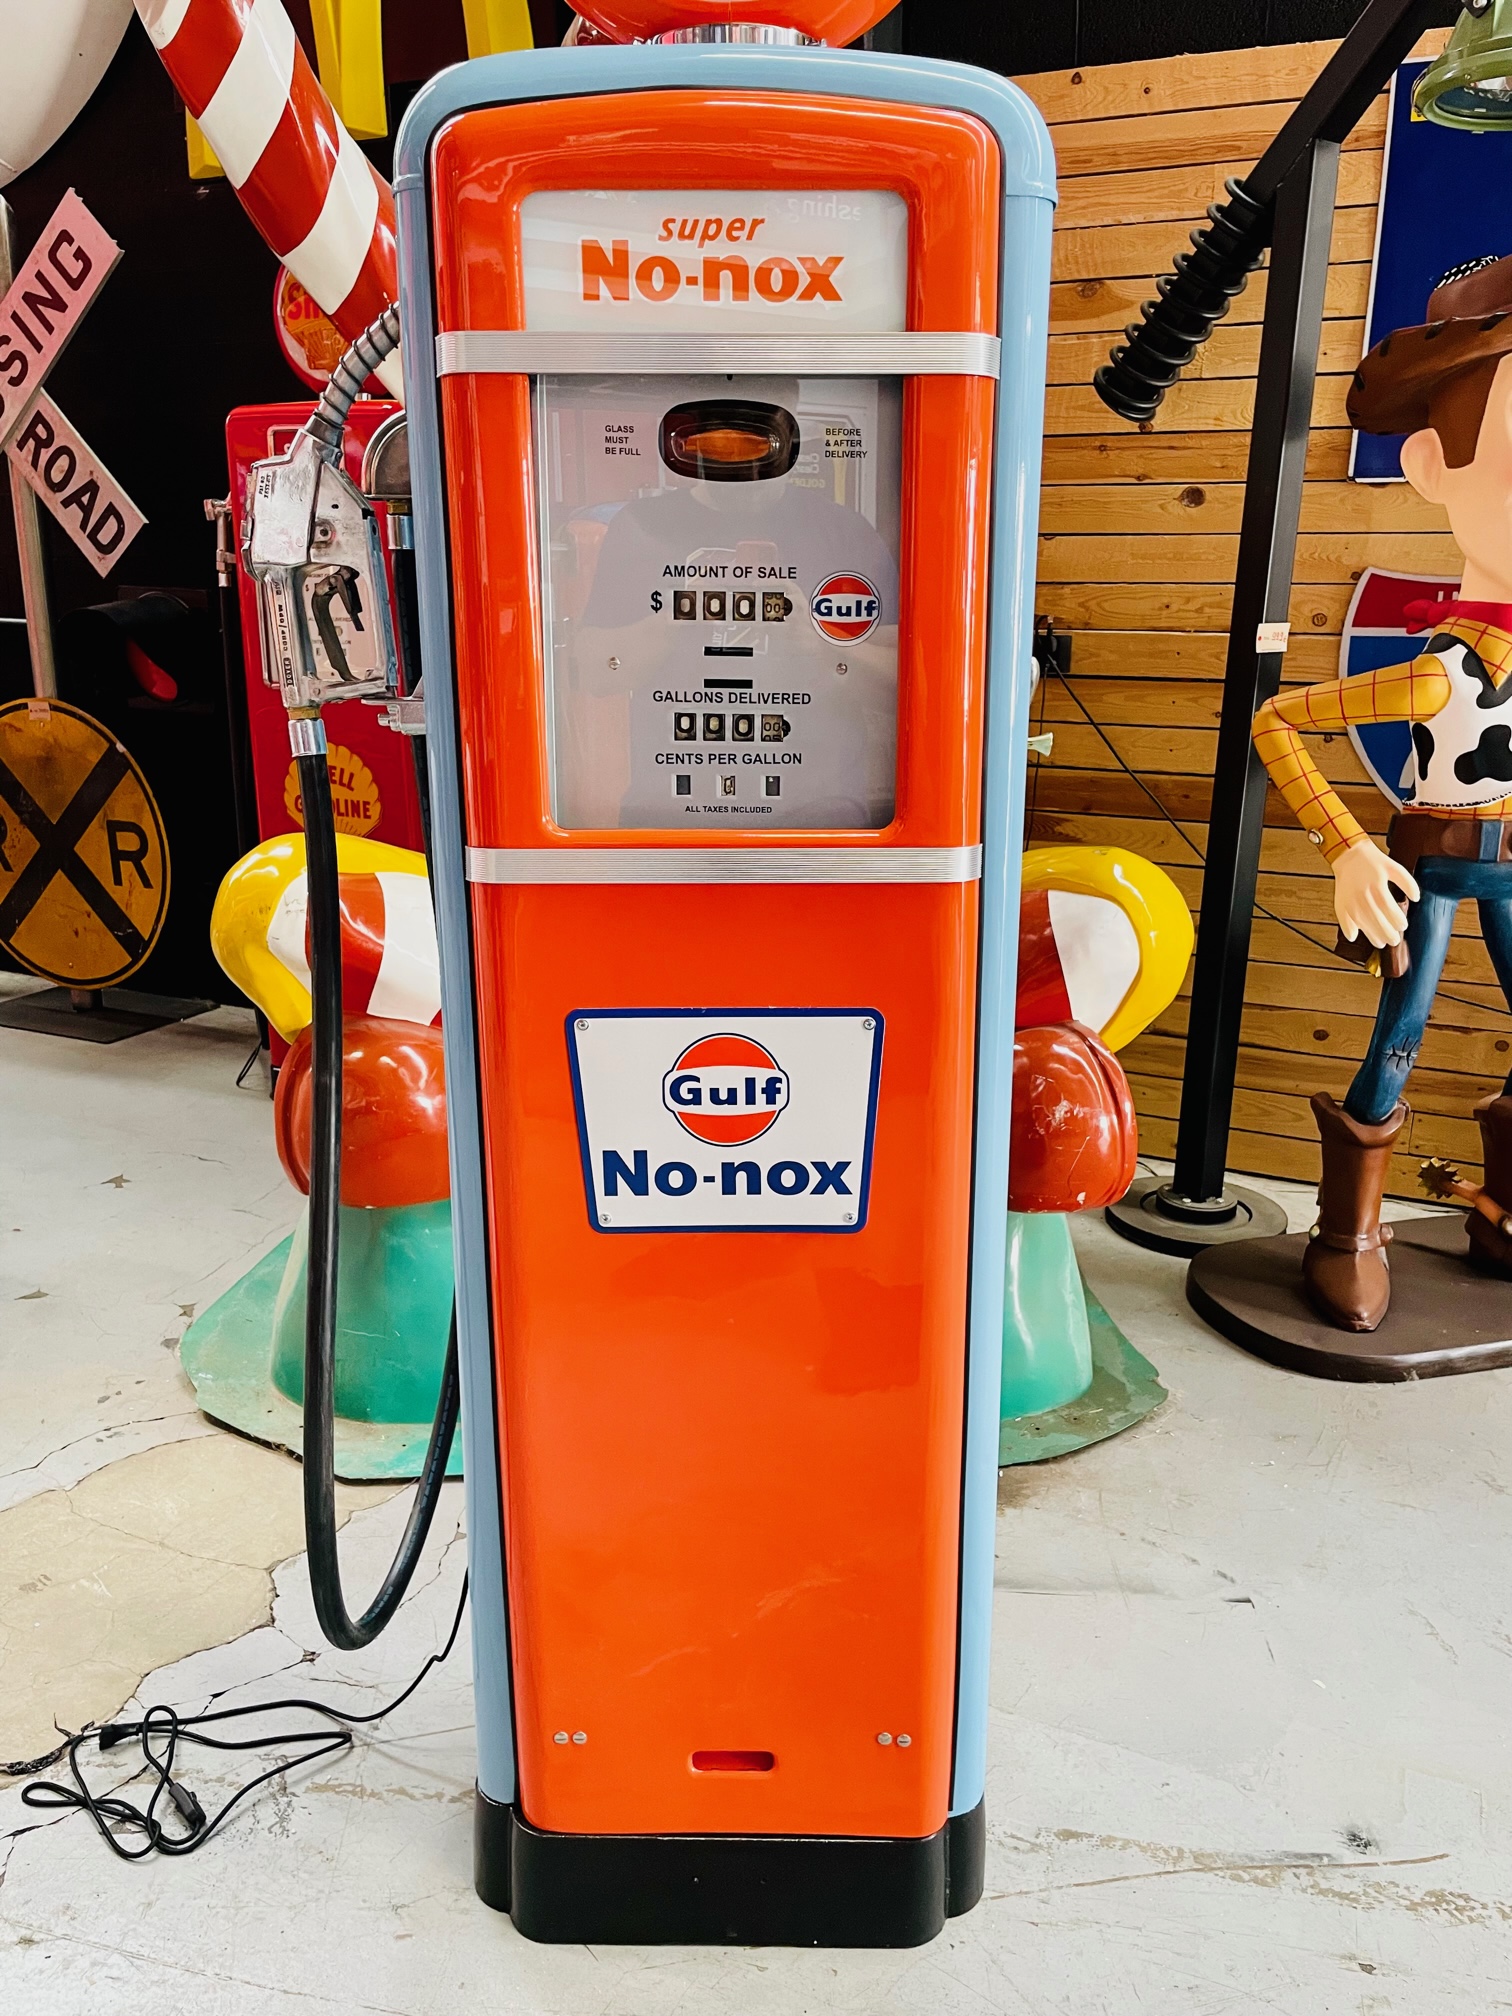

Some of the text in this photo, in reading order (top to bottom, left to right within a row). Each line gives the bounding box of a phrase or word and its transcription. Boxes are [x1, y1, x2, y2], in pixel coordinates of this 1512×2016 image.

[658, 217, 766, 248] super
[580, 239, 845, 303] No-nox
[0, 228, 93, 418] SING
[604, 424, 635, 434] GLASS
[825, 427, 862, 437] BEFORE
[604, 435, 629, 445] MUST
[824, 439, 863, 448] & AFTER
[604, 446, 642, 456] BE FULL
[824, 450, 868, 459] DELIVERY
[16, 409, 126, 556] ROAD
[662, 564, 797, 580] AMOUNT OF SALE
[650, 590, 663, 614] $
[814, 597, 878, 618] Gulf
[652, 690, 812, 705] GALLONS DELIVERED
[655, 753, 802, 765] CENTS PER GALLON
[327, 764, 355, 792] ELL
[684, 805, 773, 814] ALL TAXES INCLUDED
[106, 819, 154, 889] R
[669, 1074, 783, 1107] Gulf
[602, 1149, 854, 1197] No-nox
